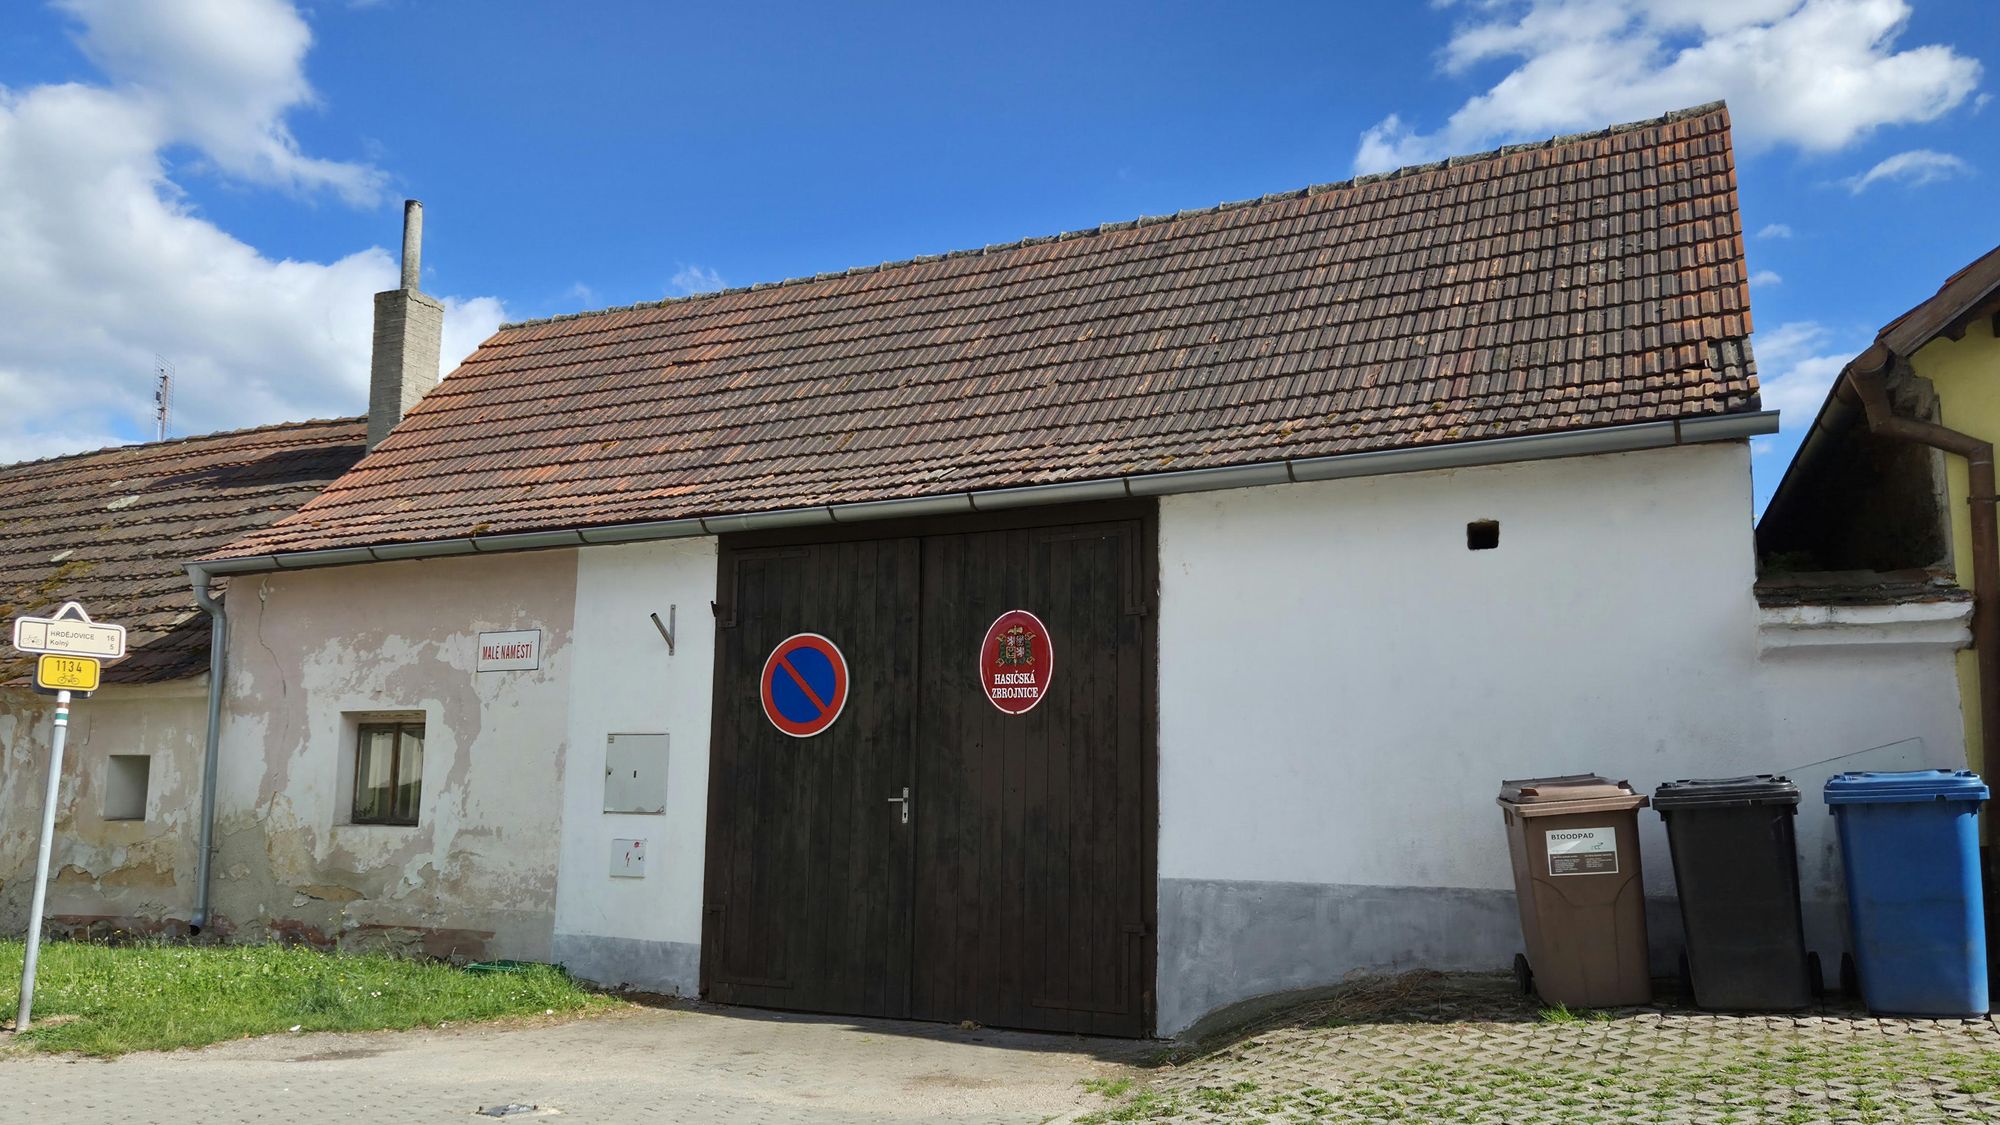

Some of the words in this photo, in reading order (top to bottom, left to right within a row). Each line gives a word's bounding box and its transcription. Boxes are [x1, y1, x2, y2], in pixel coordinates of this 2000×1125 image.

[109, 643, 114, 651] 5
[482, 642, 500, 660] MALÉ
[500, 641, 533, 660] NÁMĚSTÍ
[56, 660, 82, 673] 1134
[994, 669, 1036, 685] HASIČSKÁ
[991, 687, 1039, 699] ZBROJNICE
[1551, 832, 1595, 841] BIOODPAD
